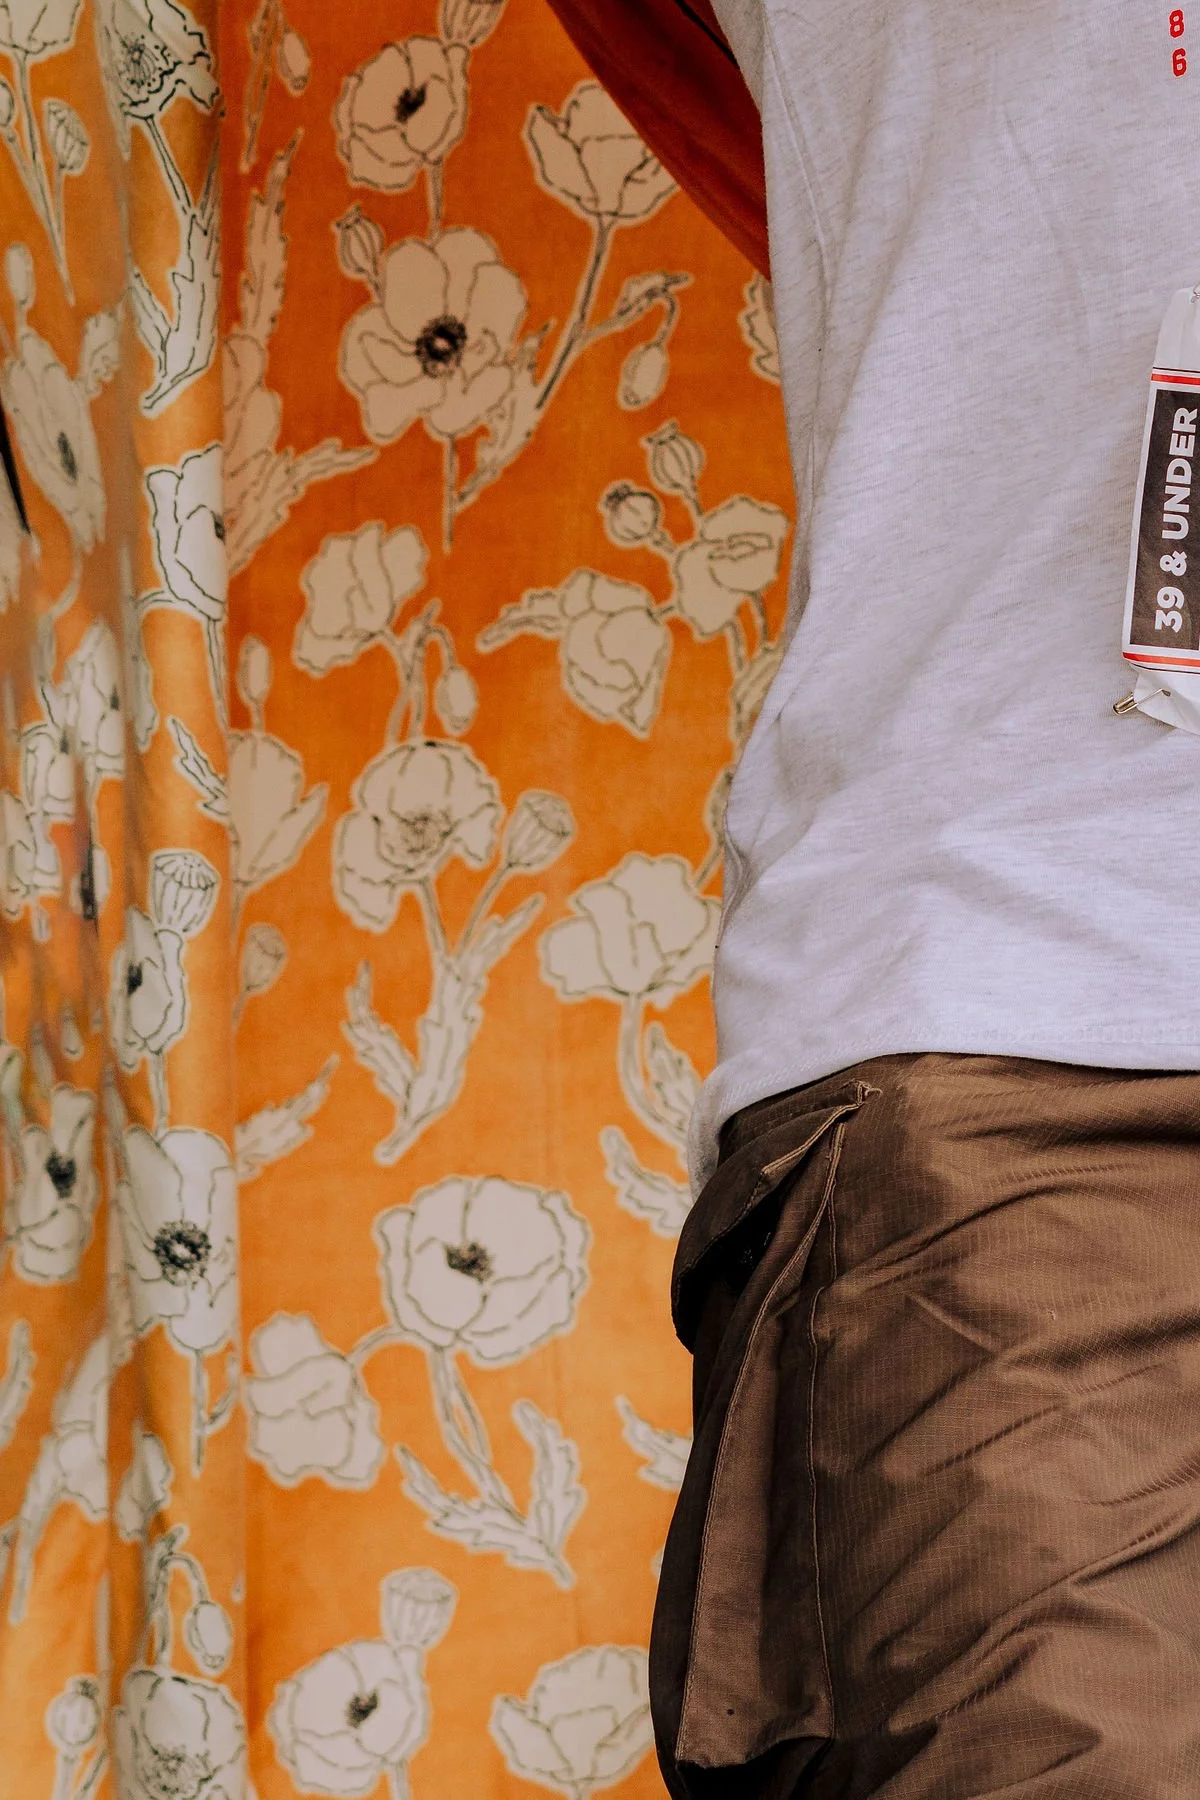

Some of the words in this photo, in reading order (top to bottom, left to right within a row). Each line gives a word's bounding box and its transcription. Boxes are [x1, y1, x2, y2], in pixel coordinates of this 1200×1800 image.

[1161, 407, 1199, 540] UNDER
[1160, 550, 1187, 577] &
[1154, 586, 1185, 633] 39
